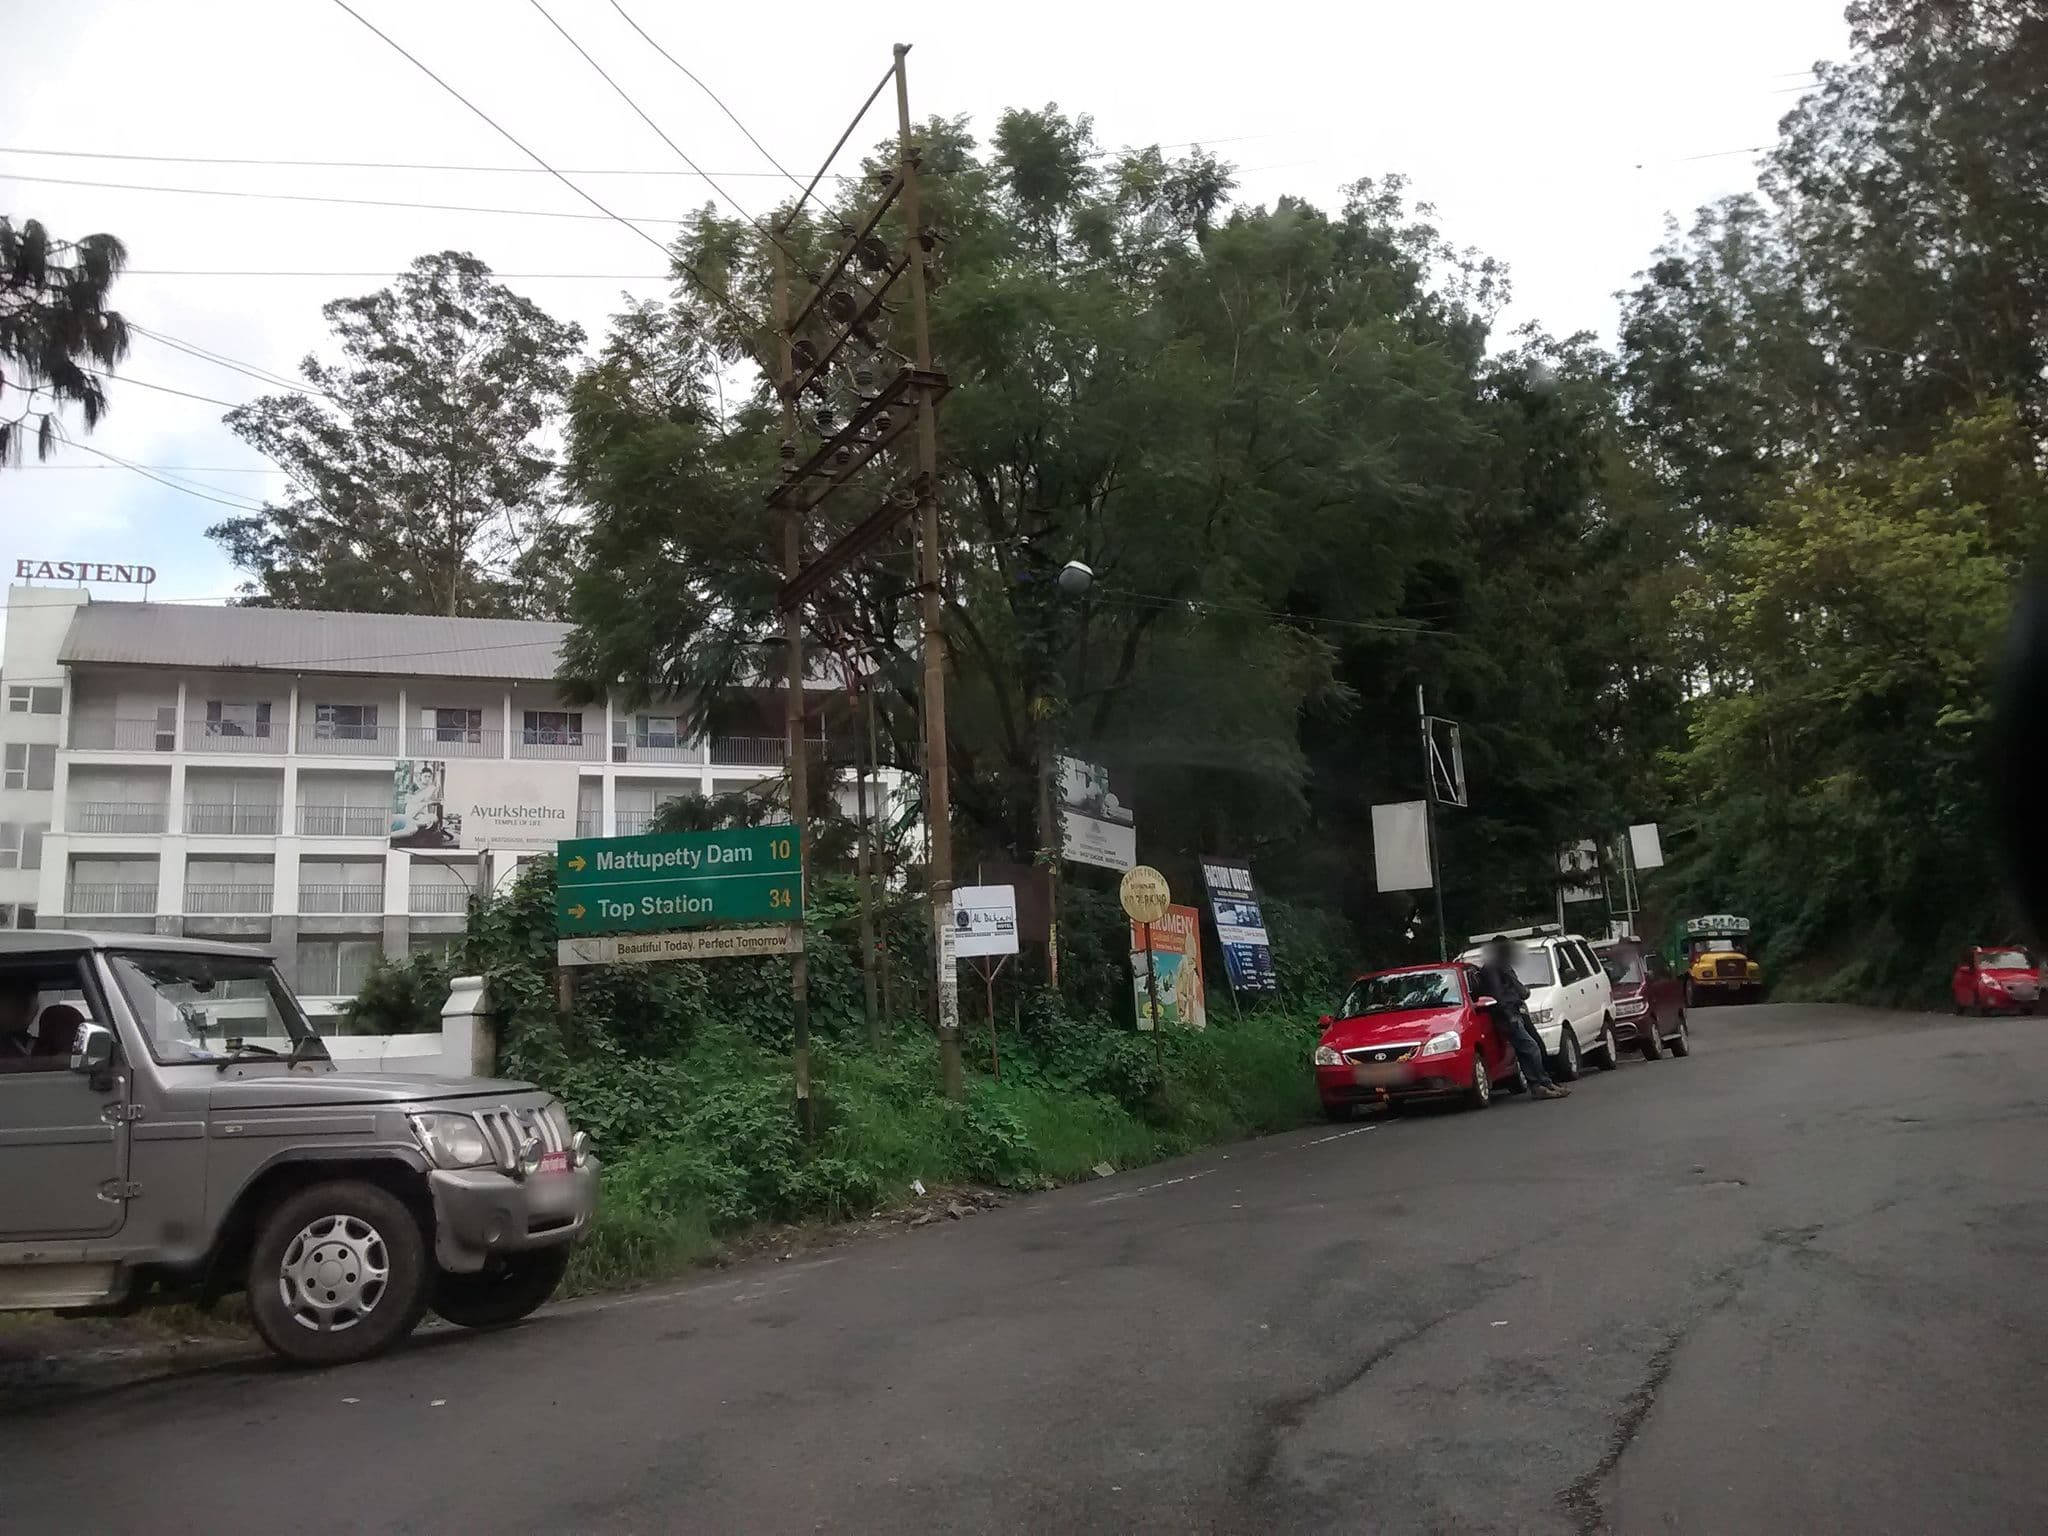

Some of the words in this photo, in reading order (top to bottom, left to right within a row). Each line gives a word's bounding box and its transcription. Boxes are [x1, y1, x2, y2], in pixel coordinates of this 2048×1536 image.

[15, 559, 156, 584] EASTEND
[470, 804, 565, 819] Ayurkshethra
[596, 848, 702, 871] Mattupetty
[707, 843, 753, 864] Dam
[770, 839, 791, 860] 10
[597, 898, 635, 921] Top
[641, 893, 713, 915] Station
[769, 888, 792, 909] 34
[617, 941, 662, 955] Beautiful
[699, 936, 734, 950] Perfect
[736, 932, 788, 948] Tomorrow
